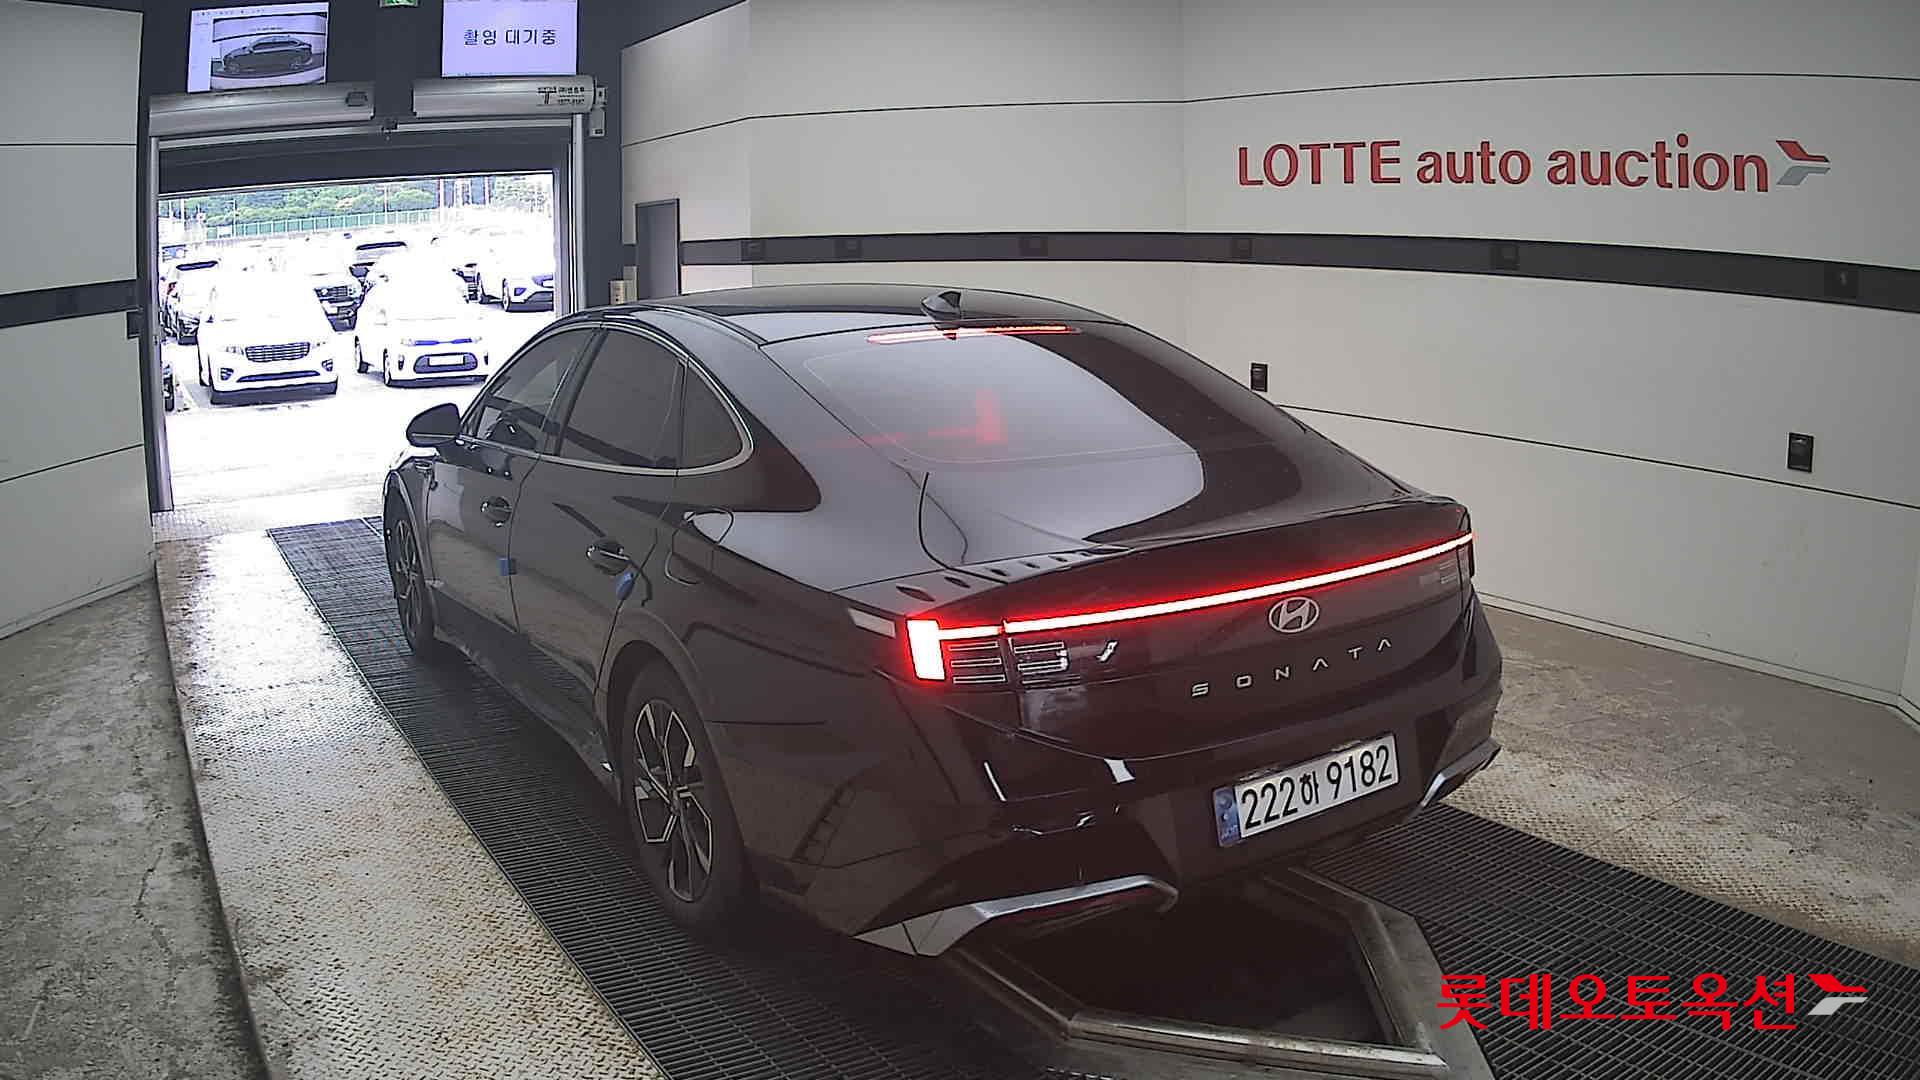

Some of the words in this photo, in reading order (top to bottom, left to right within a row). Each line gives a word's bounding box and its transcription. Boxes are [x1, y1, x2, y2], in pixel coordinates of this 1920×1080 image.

[464, 29, 497, 46] 촬영
[505, 29, 556, 46] 대기중
[1238, 140, 1401, 187] LOTTE
[1416, 140, 1532, 185] auto
[1547, 133, 1769, 192] auction
[1191, 639, 1392, 697] SONATA
[1241, 770, 1320, 830] 222하
[1326, 745, 1393, 800] 9182
